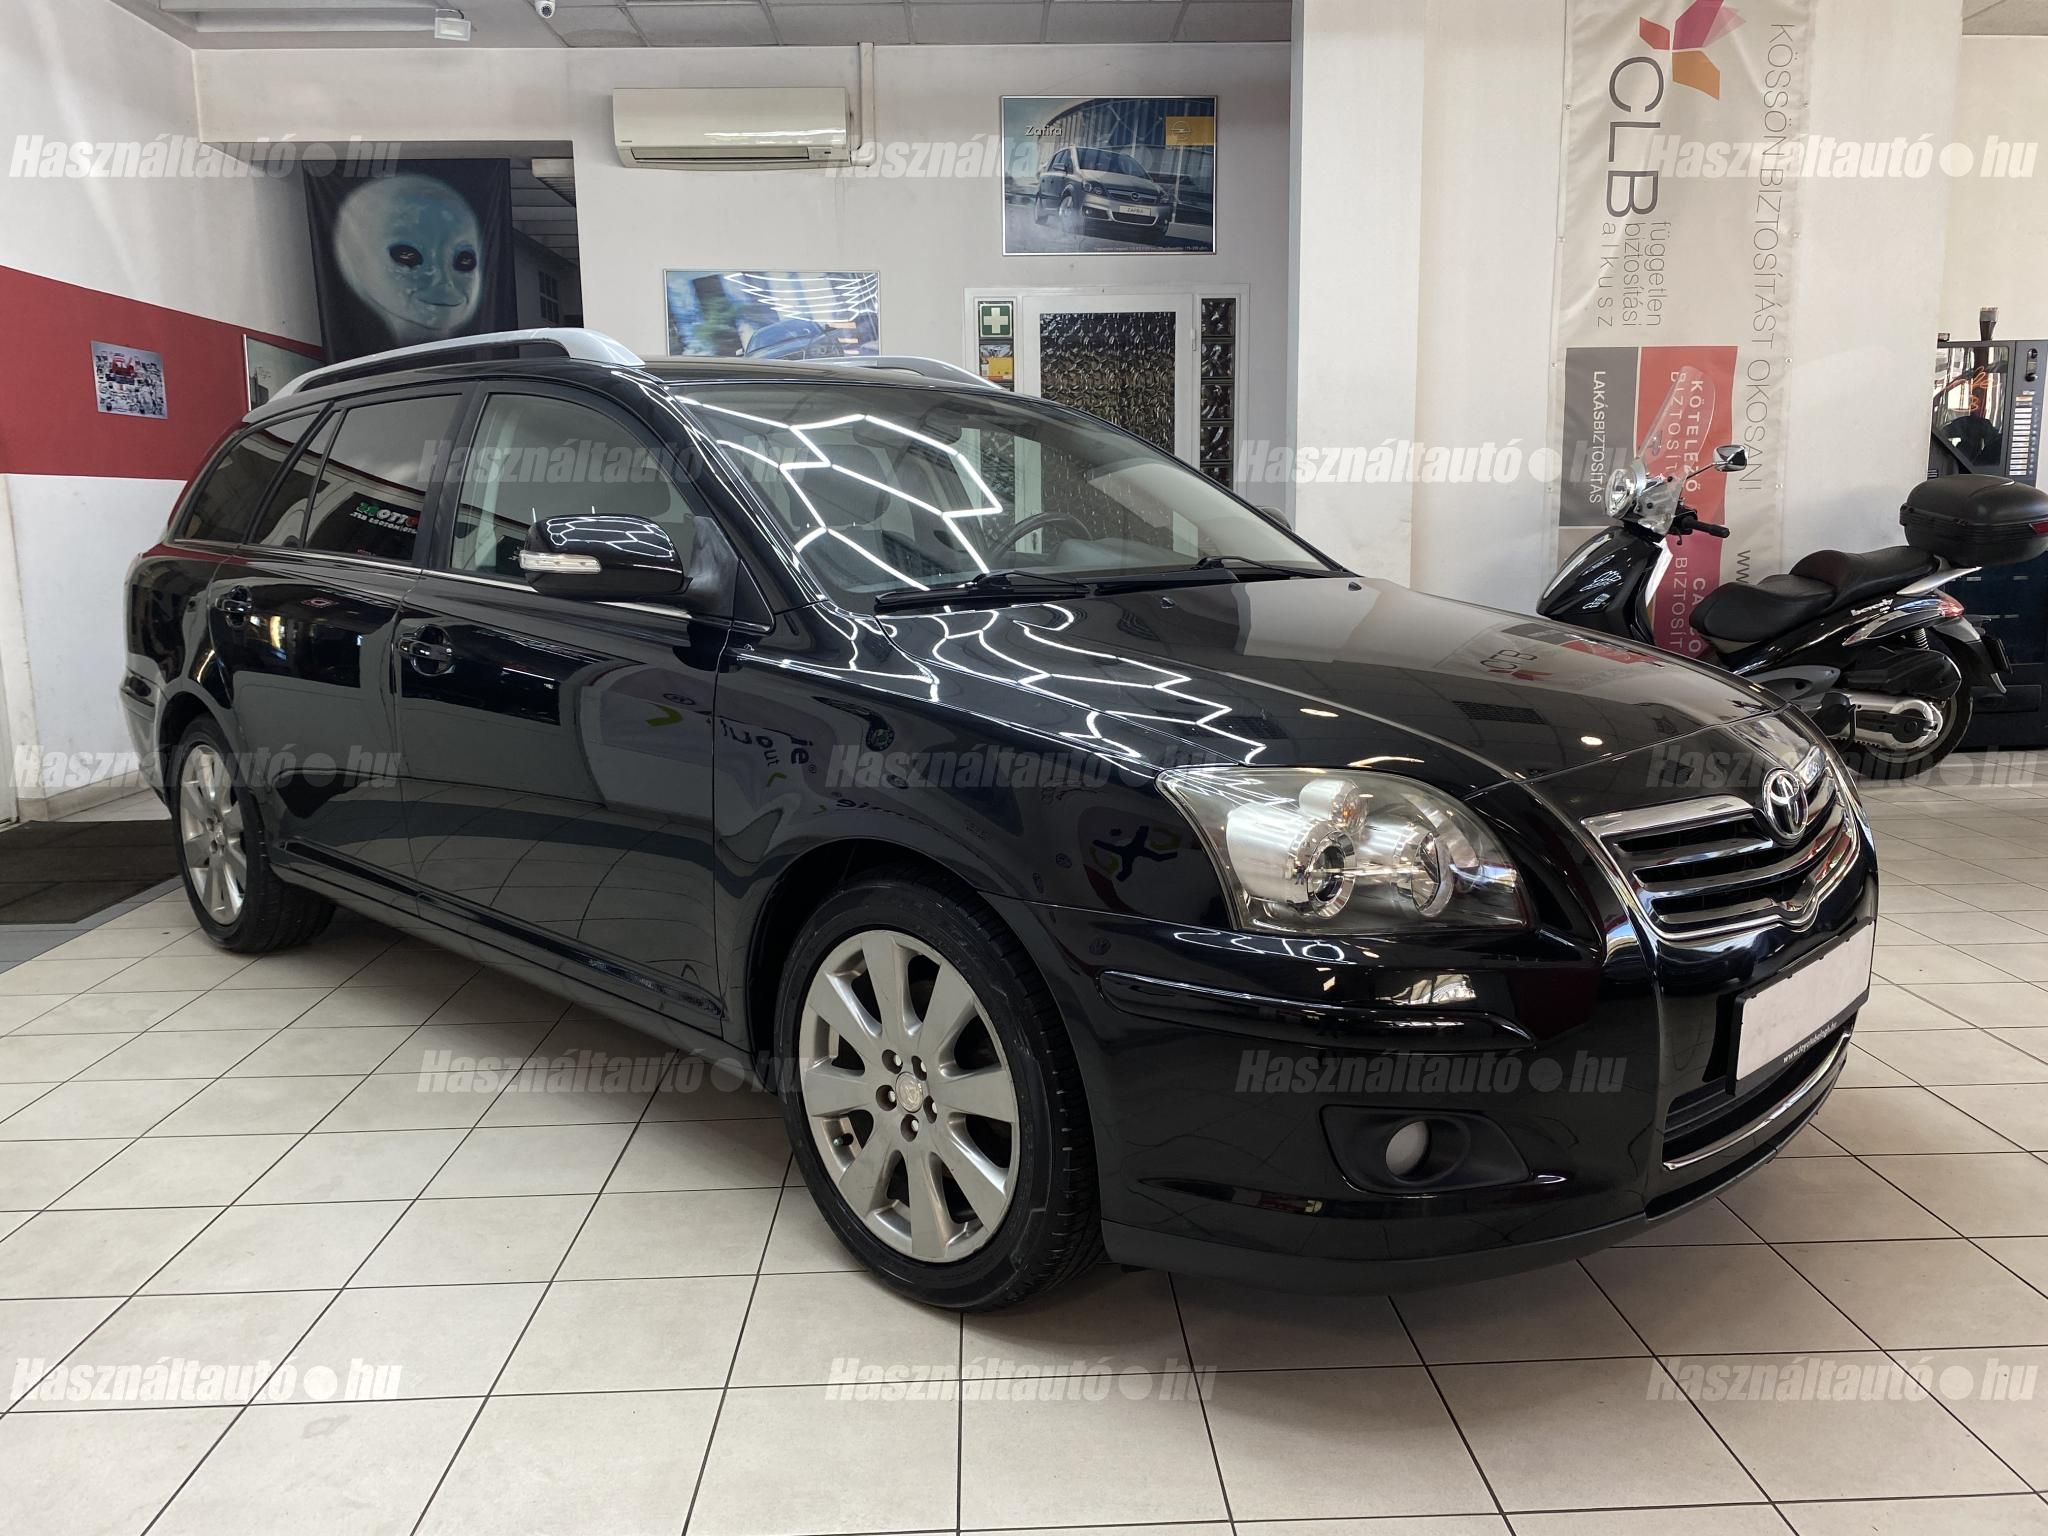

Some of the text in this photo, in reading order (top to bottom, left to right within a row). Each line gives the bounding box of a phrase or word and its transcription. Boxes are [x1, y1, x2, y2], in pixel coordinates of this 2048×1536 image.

[1025, 125, 1062, 136] Zafira
[1606, 56, 1664, 217] CLB
[1761, 23, 1799, 156] KÖSSÖN
[1622, 222, 1647, 326] biztosítási
[1644, 222, 1671, 326] független
[1751, 168, 1784, 349] BIZTOSÍTÁST
[1589, 371, 1609, 504] LAKÁSBIZTOSÍTÁS
[1683, 380, 1705, 492] KÖTELEZŐ
[1688, 577, 1706, 653] CAO
